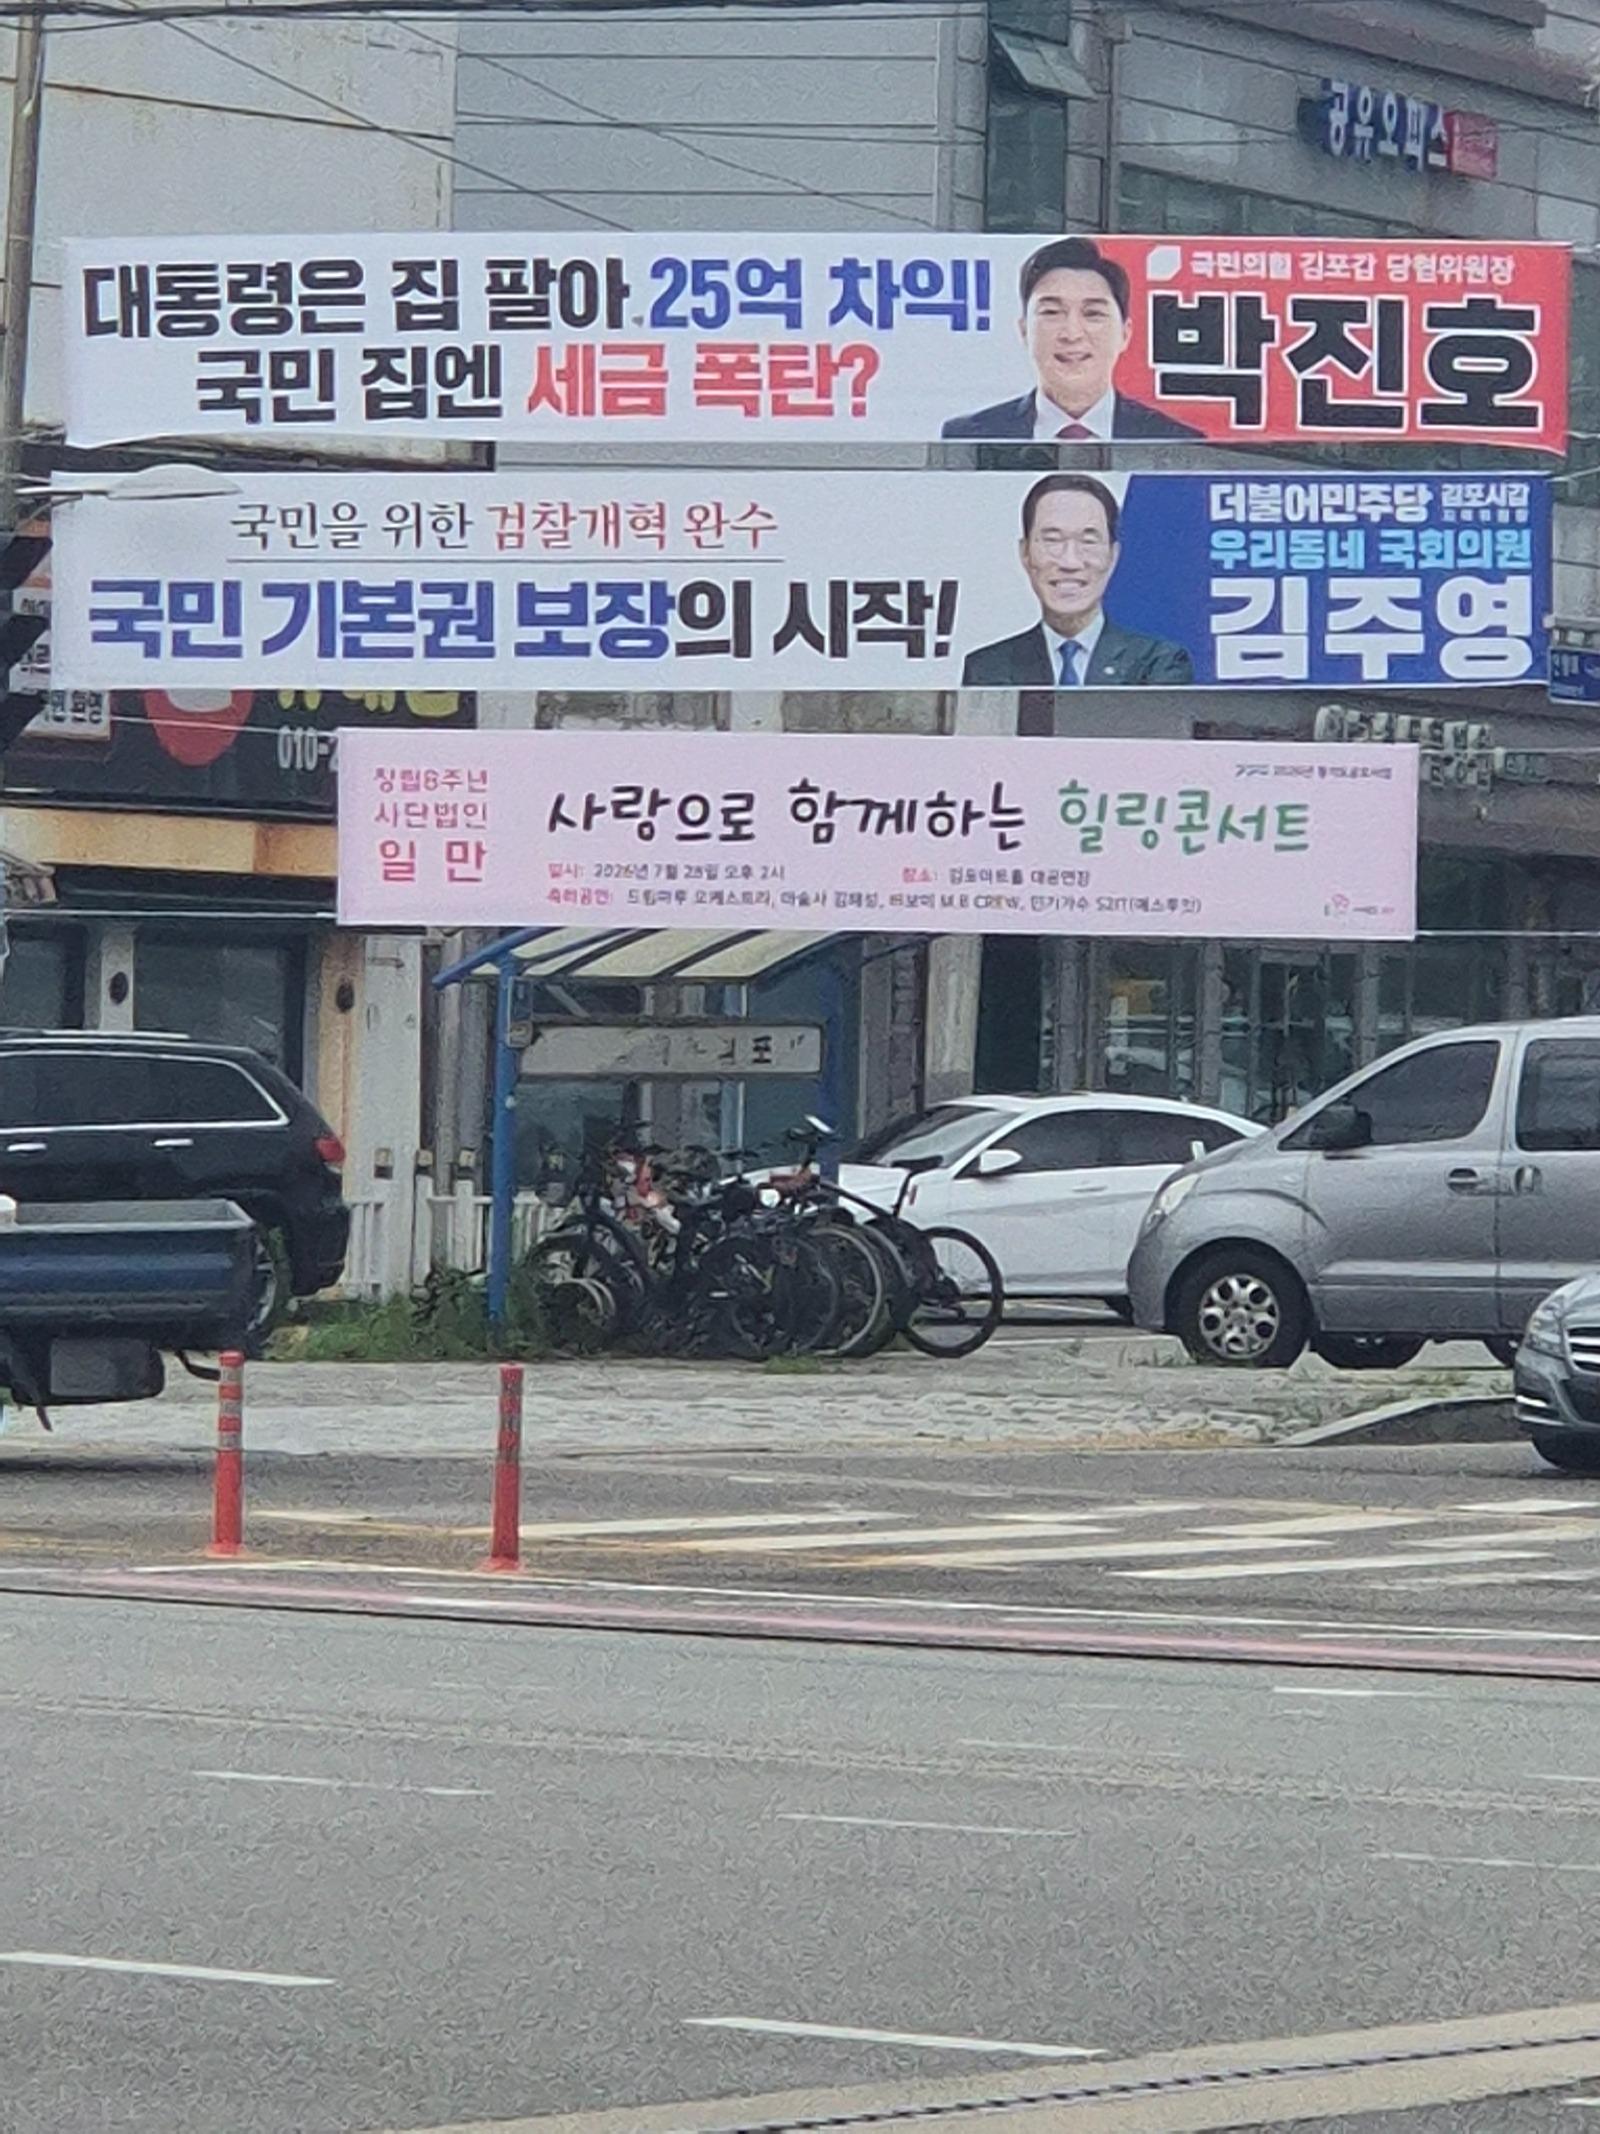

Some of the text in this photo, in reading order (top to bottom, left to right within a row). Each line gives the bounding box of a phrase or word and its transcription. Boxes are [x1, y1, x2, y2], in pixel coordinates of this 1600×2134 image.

[1328, 81, 1448, 171] 공유오피스
[1190, 251, 1514, 285] 국민의힘 김포갑 당협위원장
[82, 257, 990, 338] 대통령은 집 팔아 25억 차익!
[197, 342, 880, 424] 국민 집엔 세금 폭탄?
[1151, 292, 1546, 433] 박진호
[230, 501, 778, 551] 국민을 위한 검찰개혁 완수
[1209, 482, 1433, 523] 더불어민주당
[1441, 483, 1530, 507] 김포시갑
[1209, 528, 1533, 570] 우리동네 국회의원
[89, 579, 959, 660] 국민 기본권 보장의 시작!
[1210, 575, 1533, 682] 김주영
[374, 803, 488, 829] 사단법인
[548, 778, 1311, 855] 사랑으로 함께하는 힐링콘서트
[379, 840, 488, 883] 일 만
[725, 864, 753, 880] 오후
[760, 865, 785, 880] 2시
[780, 891, 827, 907] 마술사
